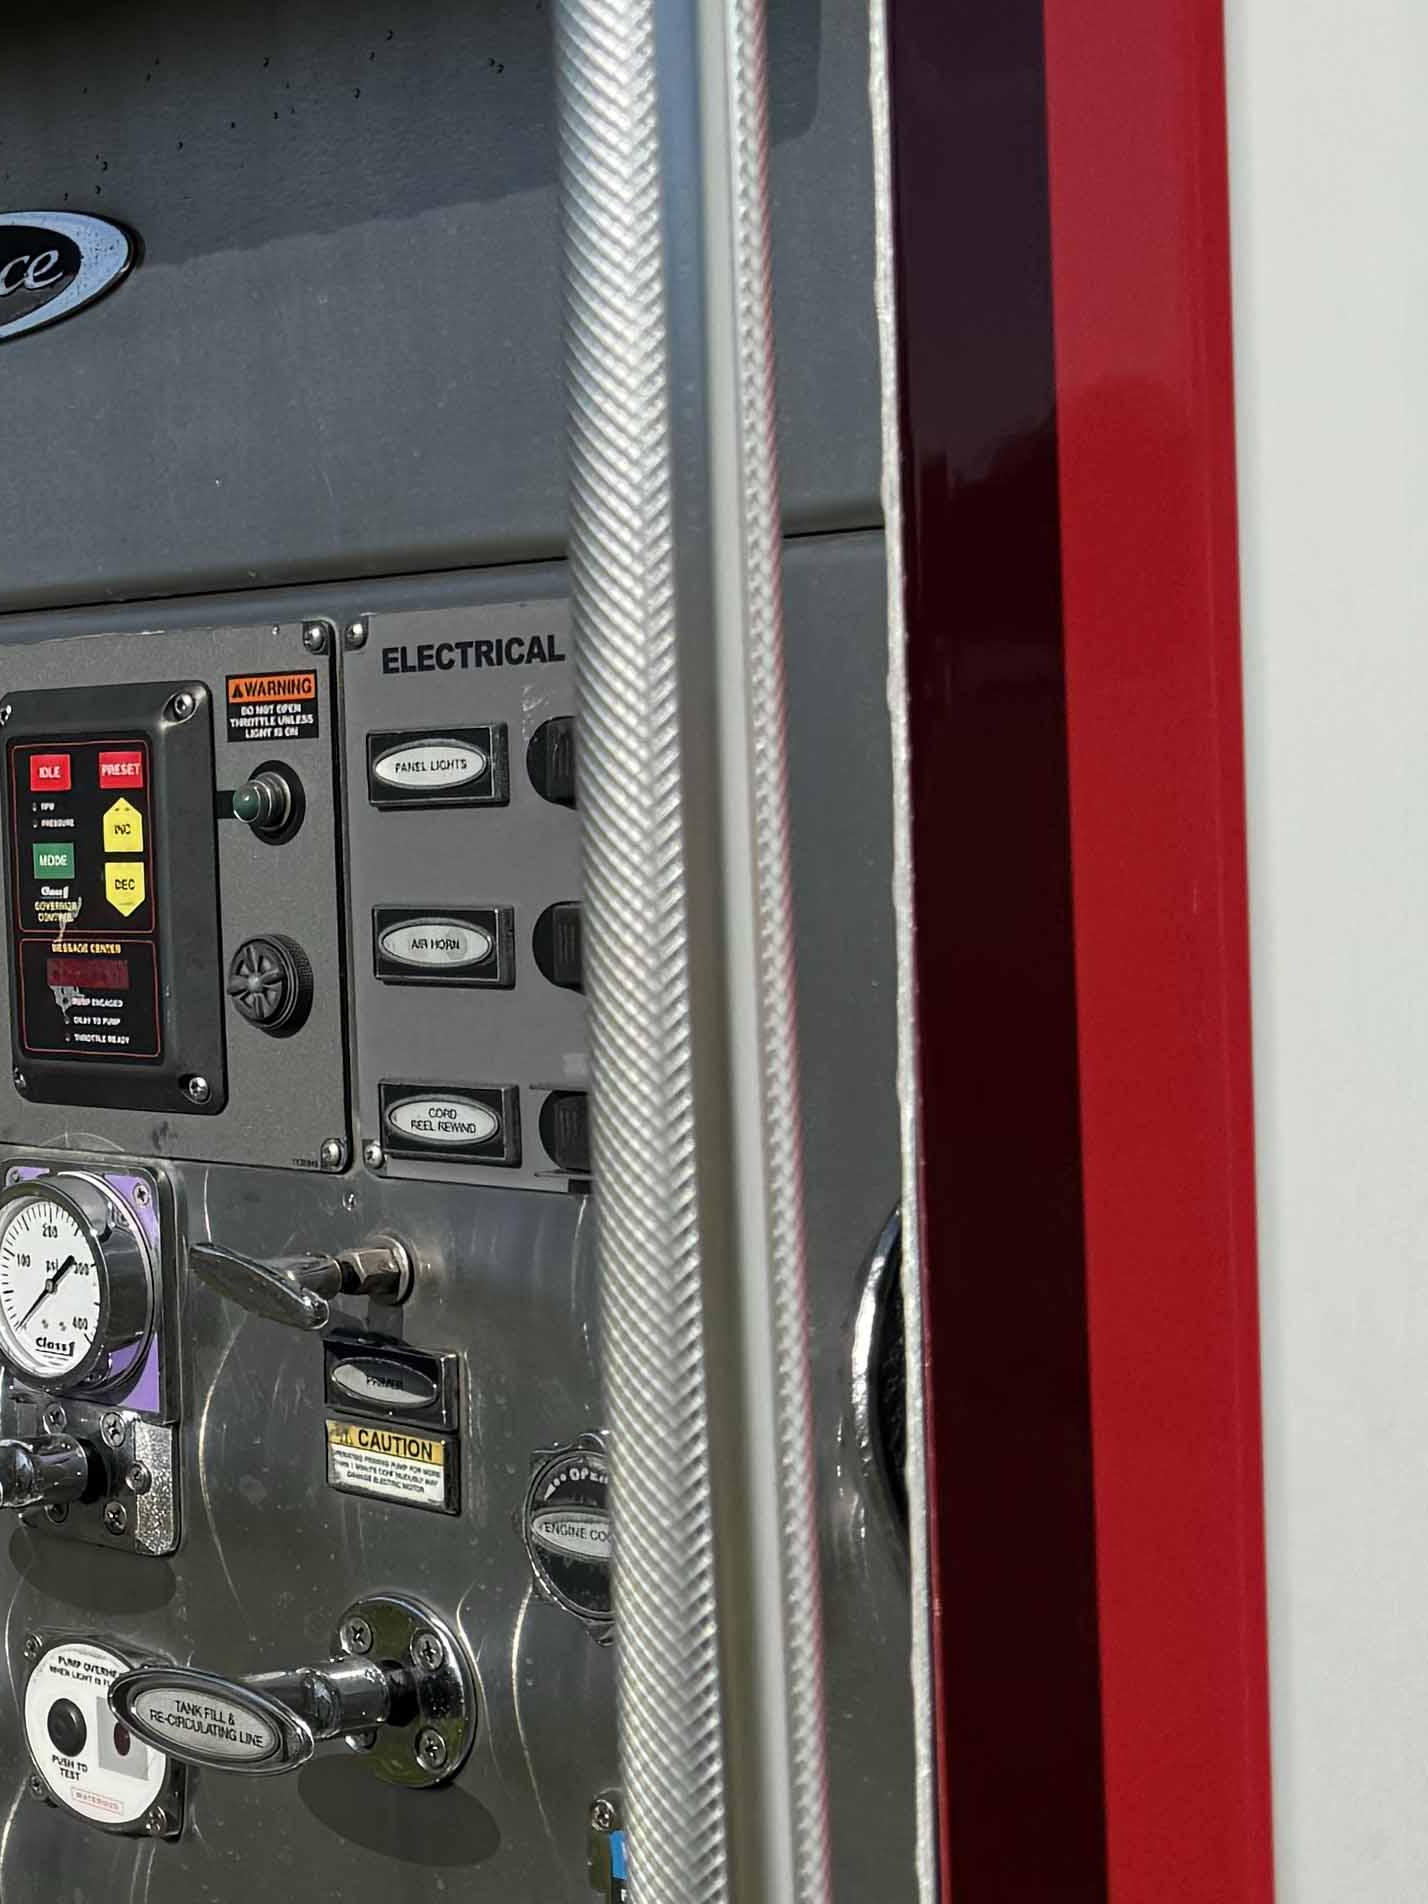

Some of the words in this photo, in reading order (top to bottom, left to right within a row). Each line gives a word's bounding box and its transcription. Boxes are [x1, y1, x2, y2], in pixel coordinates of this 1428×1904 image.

[382, 634, 565, 674] ELECTRICAL
[245, 678, 311, 696] WARNING
[241, 706, 254, 716] DO
[256, 705, 274, 714] NOT
[276, 704, 302, 714] OPEN
[230, 716, 276, 727] THROTTLE
[278, 714, 314, 725] UNLESS
[245, 728, 272, 738] LIGHT
[274, 728, 283, 737] IS
[285, 727, 298, 736] ON
[39, 766, 61, 779] IDLE
[101, 763, 140, 776] PRESET
[395, 761, 427, 774] PANEL
[430, 758, 467, 772] LIGHTS
[114, 824, 131, 834] INC
[40, 855, 67, 866] MODE
[114, 879, 135, 890] DEC
[411, 938, 429, 950] AIR
[430, 938, 460, 950] HORN
[428, 1107, 457, 1120] CORD
[411, 1119, 434, 1132] REEL
[438, 1121, 476, 1134] REWIND
[42, 1224, 58, 1239] 200
[16, 1254, 31, 1267] 100
[74, 1262, 90, 1276] 300
[72, 1316, 88, 1331] 400
[358, 1429, 433, 1461] CAUTION
[544, 1521, 587, 1540] ENGINE
[58, 1655, 81, 1669] PUMP
[72, 1671, 93, 1684] LIGHT
[175, 1700, 202, 1718] TANK
[204, 1707, 226, 1724] FILL
[228, 1713, 235, 1726] &
[150, 1709, 237, 1742] RE-CIRCULATING
[240, 1731, 264, 1748] LINE
[52, 1755, 75, 1770] PUSH
[77, 1761, 88, 1773] TO
[59, 1768, 80, 1781] TEST
